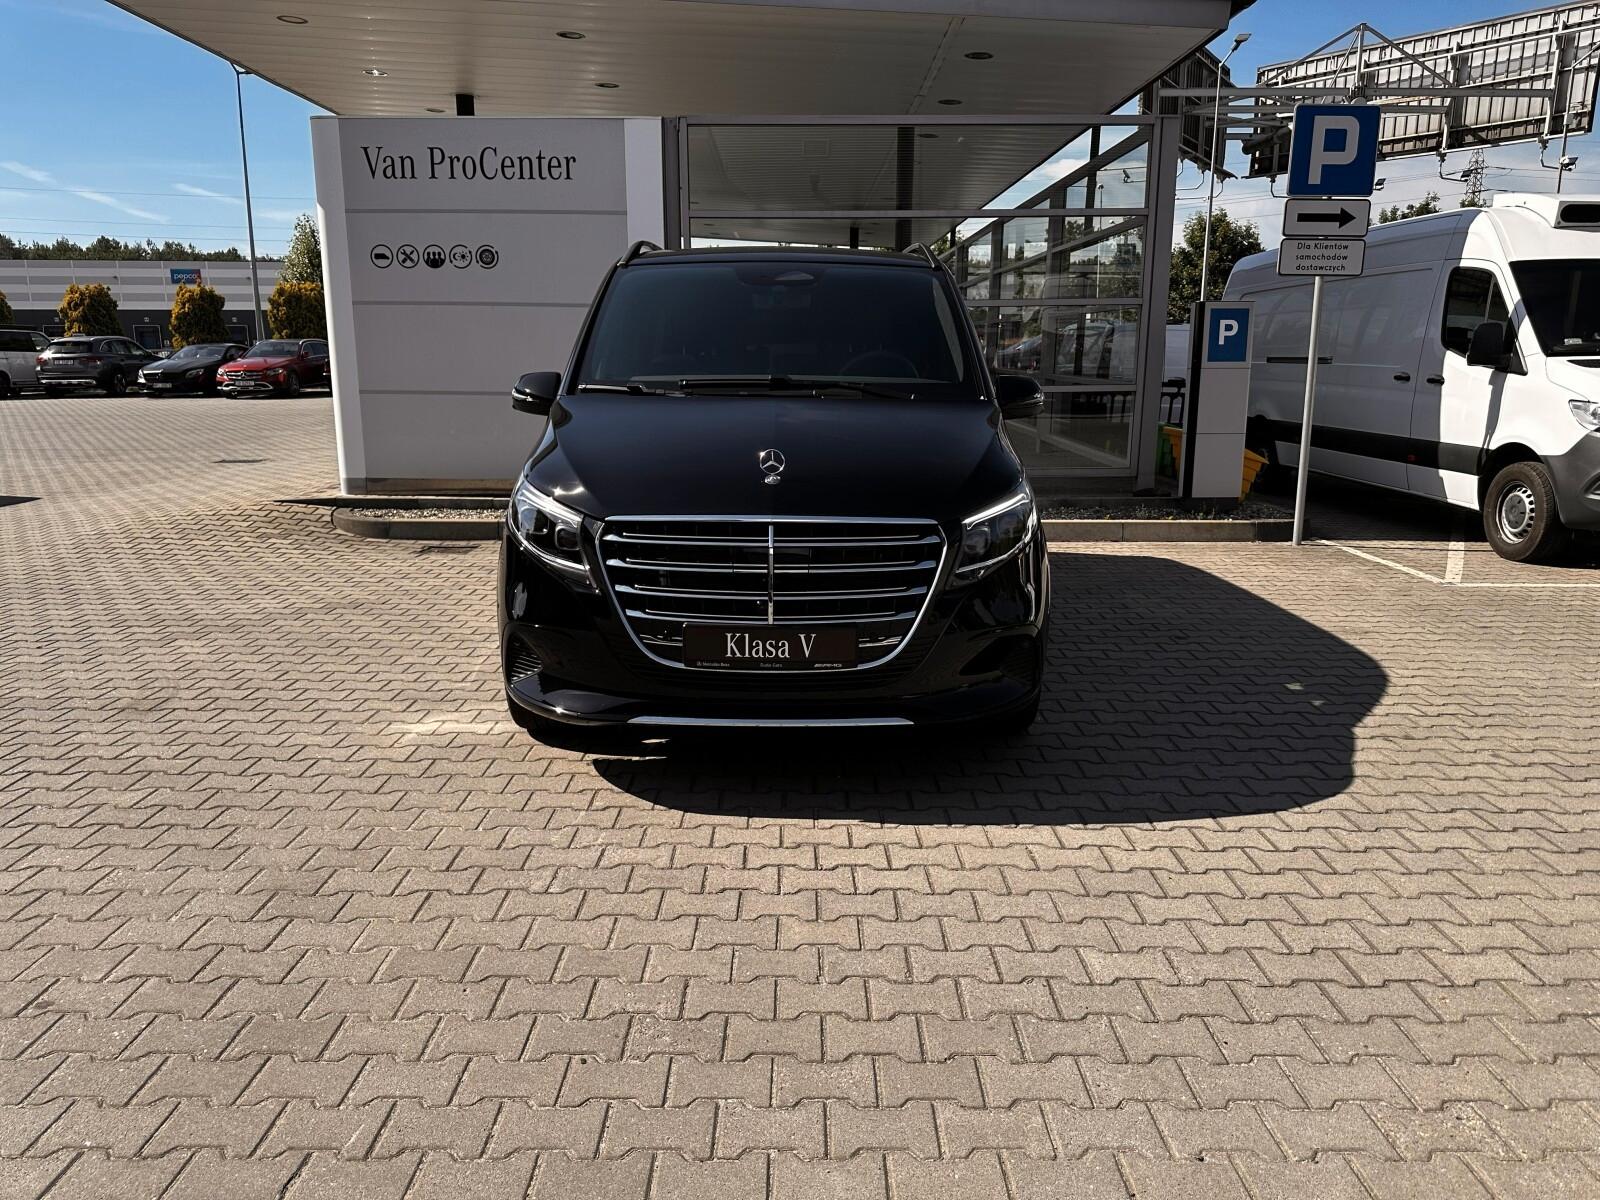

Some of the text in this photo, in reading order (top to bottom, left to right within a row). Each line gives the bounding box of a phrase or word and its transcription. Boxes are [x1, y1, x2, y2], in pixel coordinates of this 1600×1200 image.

[1308, 115, 1360, 184] P
[360, 146, 577, 180] Van ProCenter
[1296, 242, 1311, 251] Dla
[1295, 264, 1346, 273] dostawczych
[1218, 319, 1239, 345] P
[725, 632, 817, 659] Klasa V
